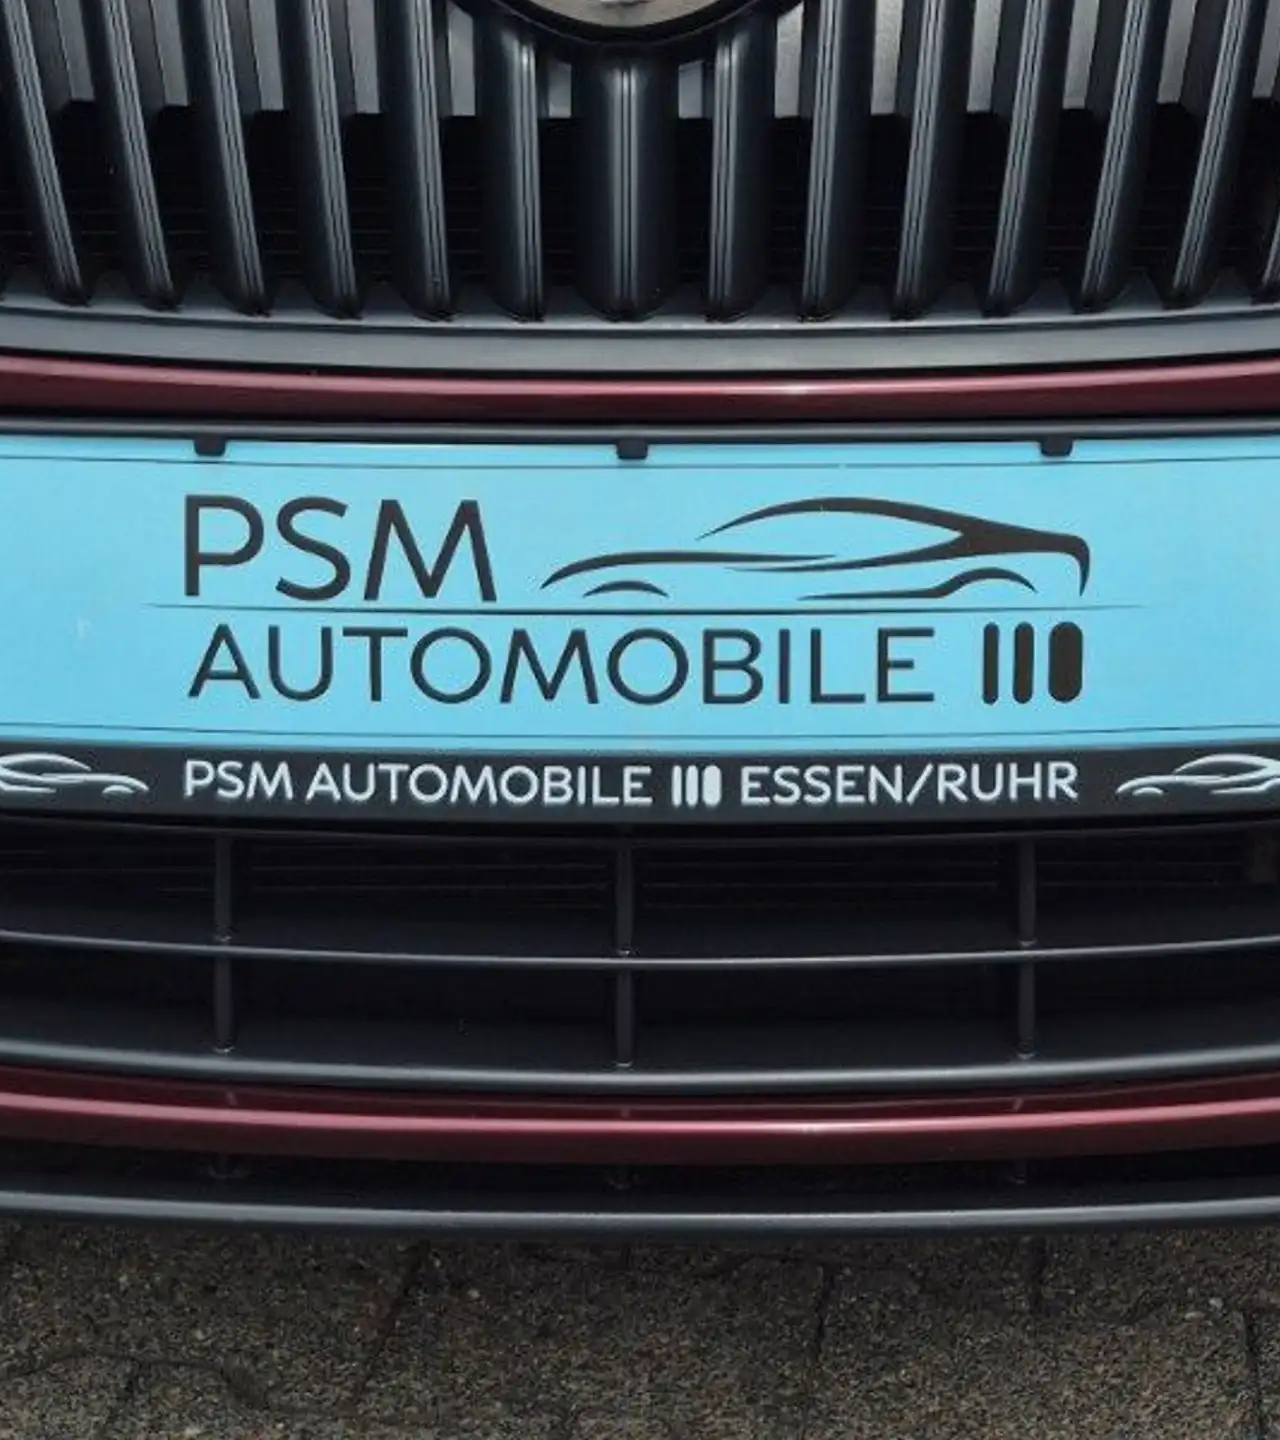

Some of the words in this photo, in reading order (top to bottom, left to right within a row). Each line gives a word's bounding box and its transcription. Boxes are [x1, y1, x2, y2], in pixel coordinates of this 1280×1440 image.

[185, 495, 497, 602] PSM
[188, 623, 935, 706] AUTOMOBILE
[185, 759, 294, 800] PSM
[305, 762, 653, 805] AUTOMOBILE
[741, 761, 1078, 805] ESSEN/RUHR
